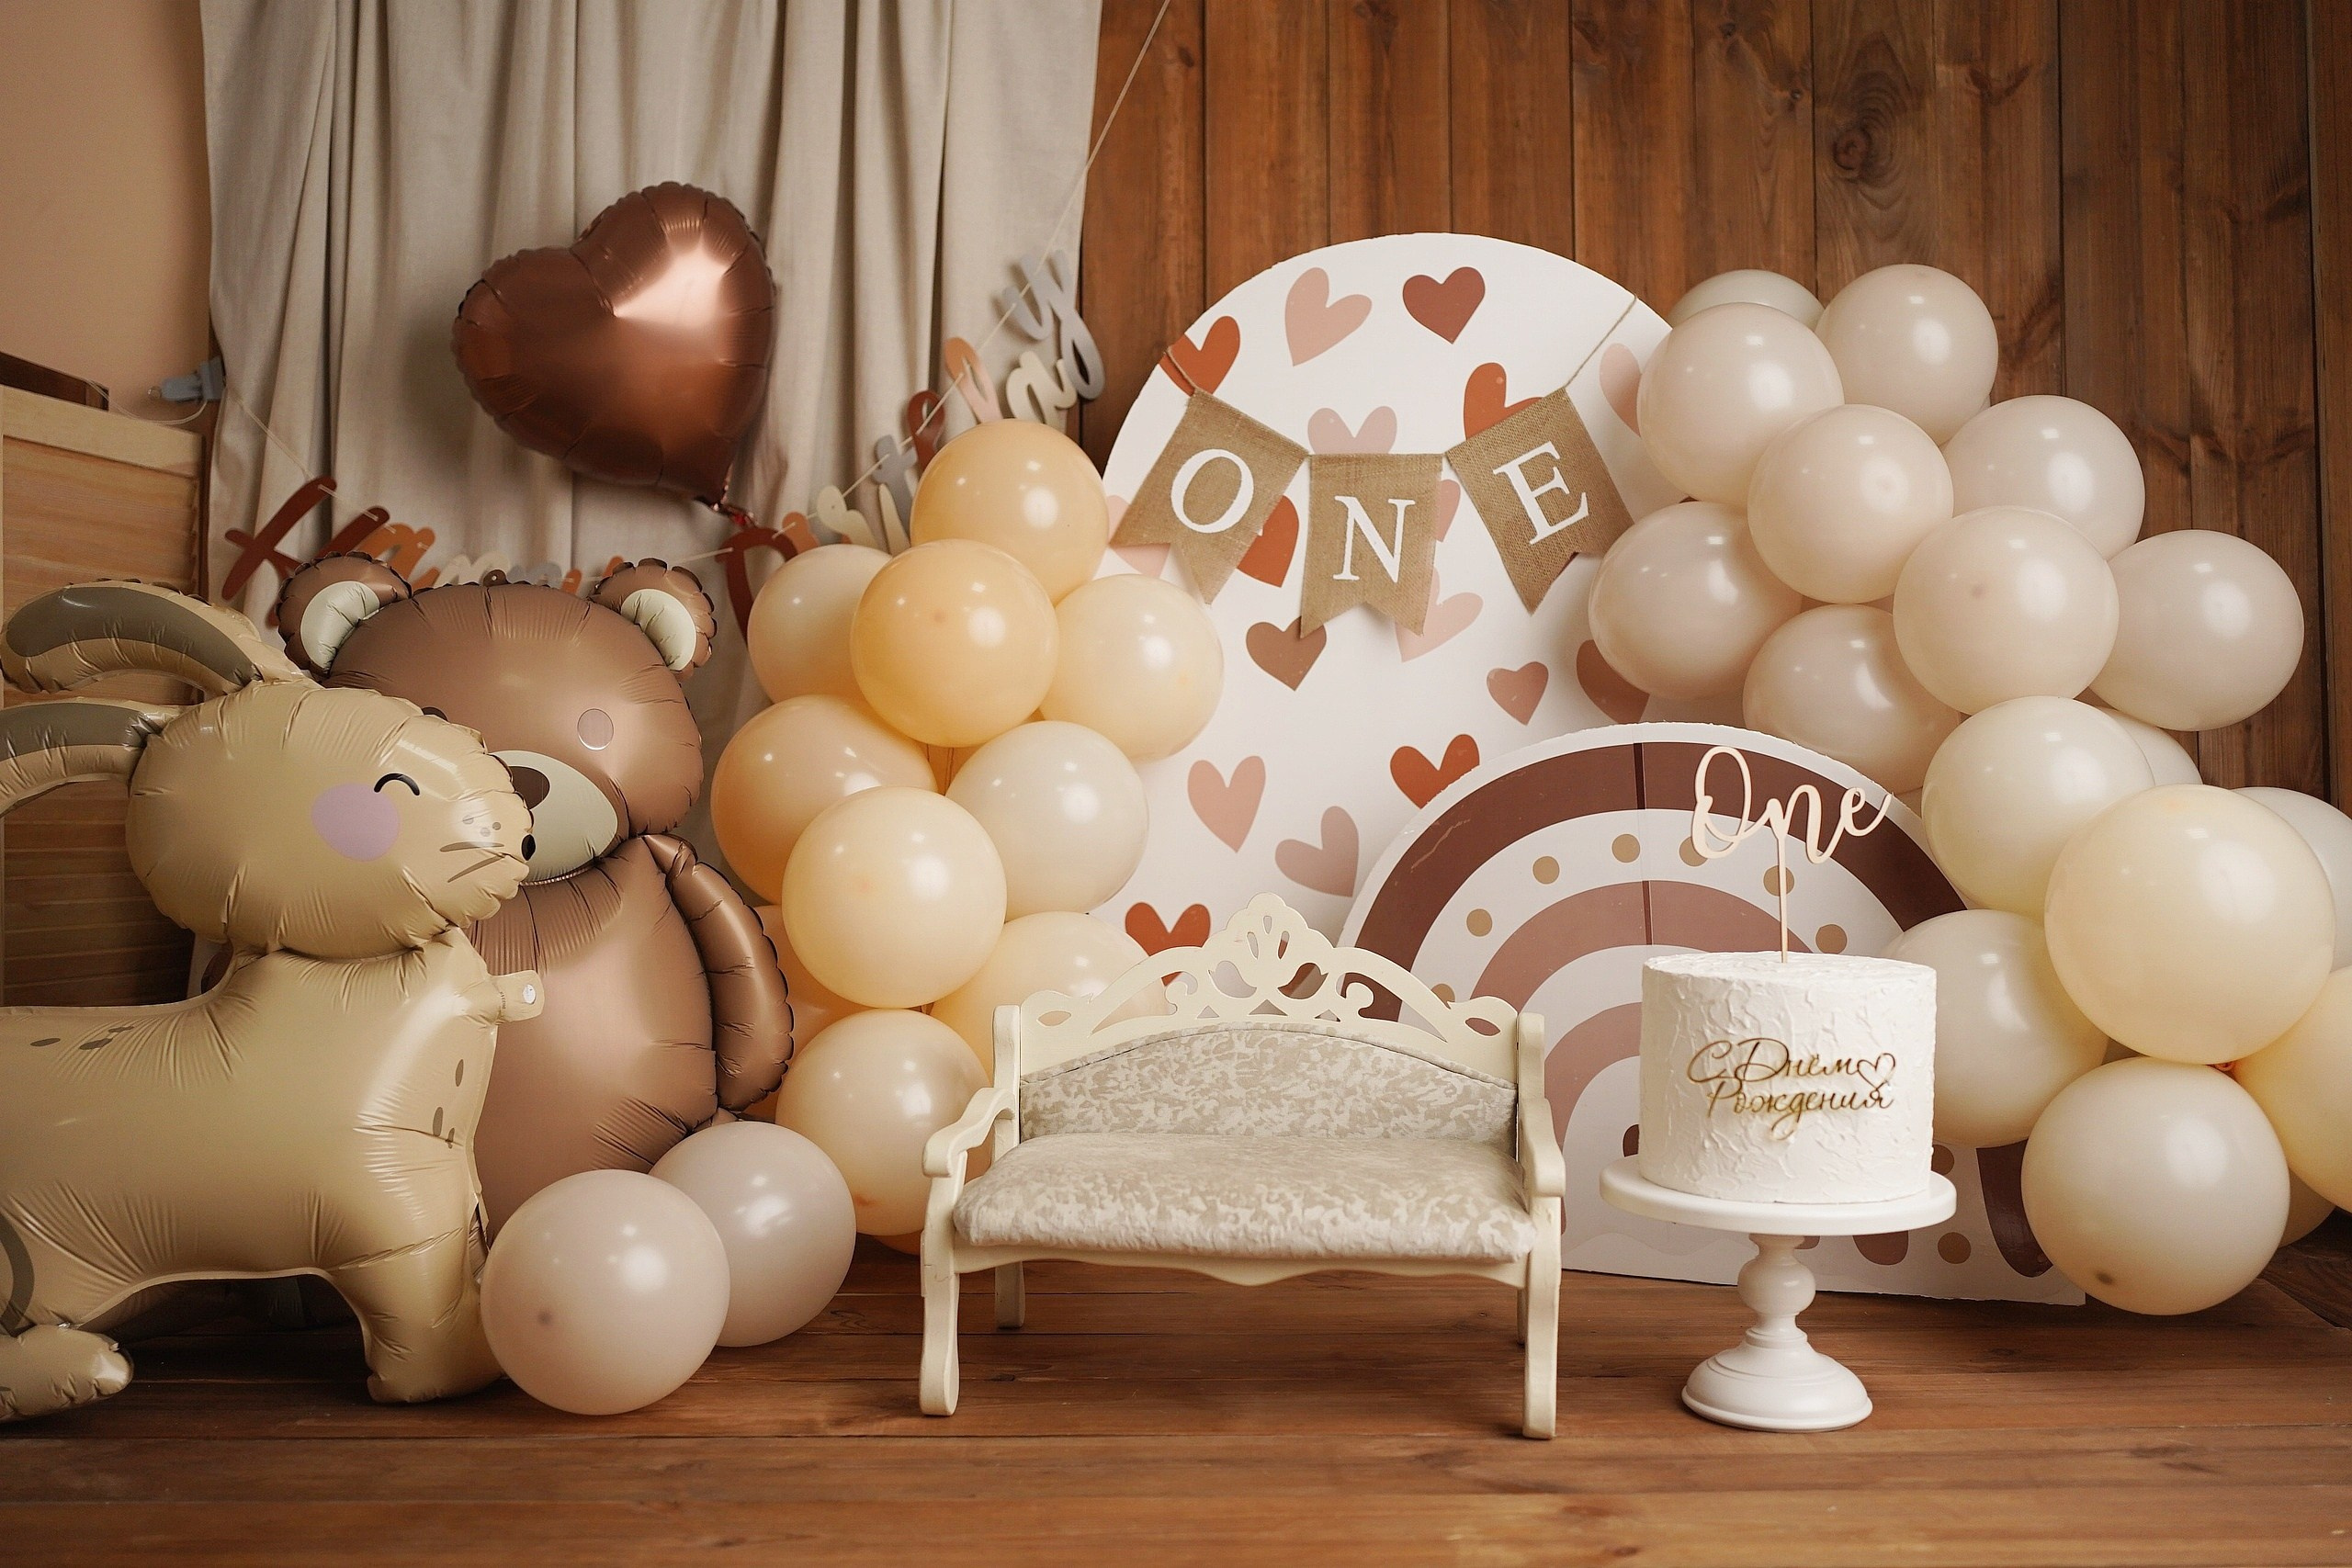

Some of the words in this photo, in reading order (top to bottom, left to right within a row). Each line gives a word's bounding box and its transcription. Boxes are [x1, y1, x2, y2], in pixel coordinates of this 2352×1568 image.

[1170, 441, 1589, 583] ONE
[1691, 746, 1894, 863] One
[1687, 1040, 1732, 1083] С
[1707, 1077, 1894, 1141] Рождения
